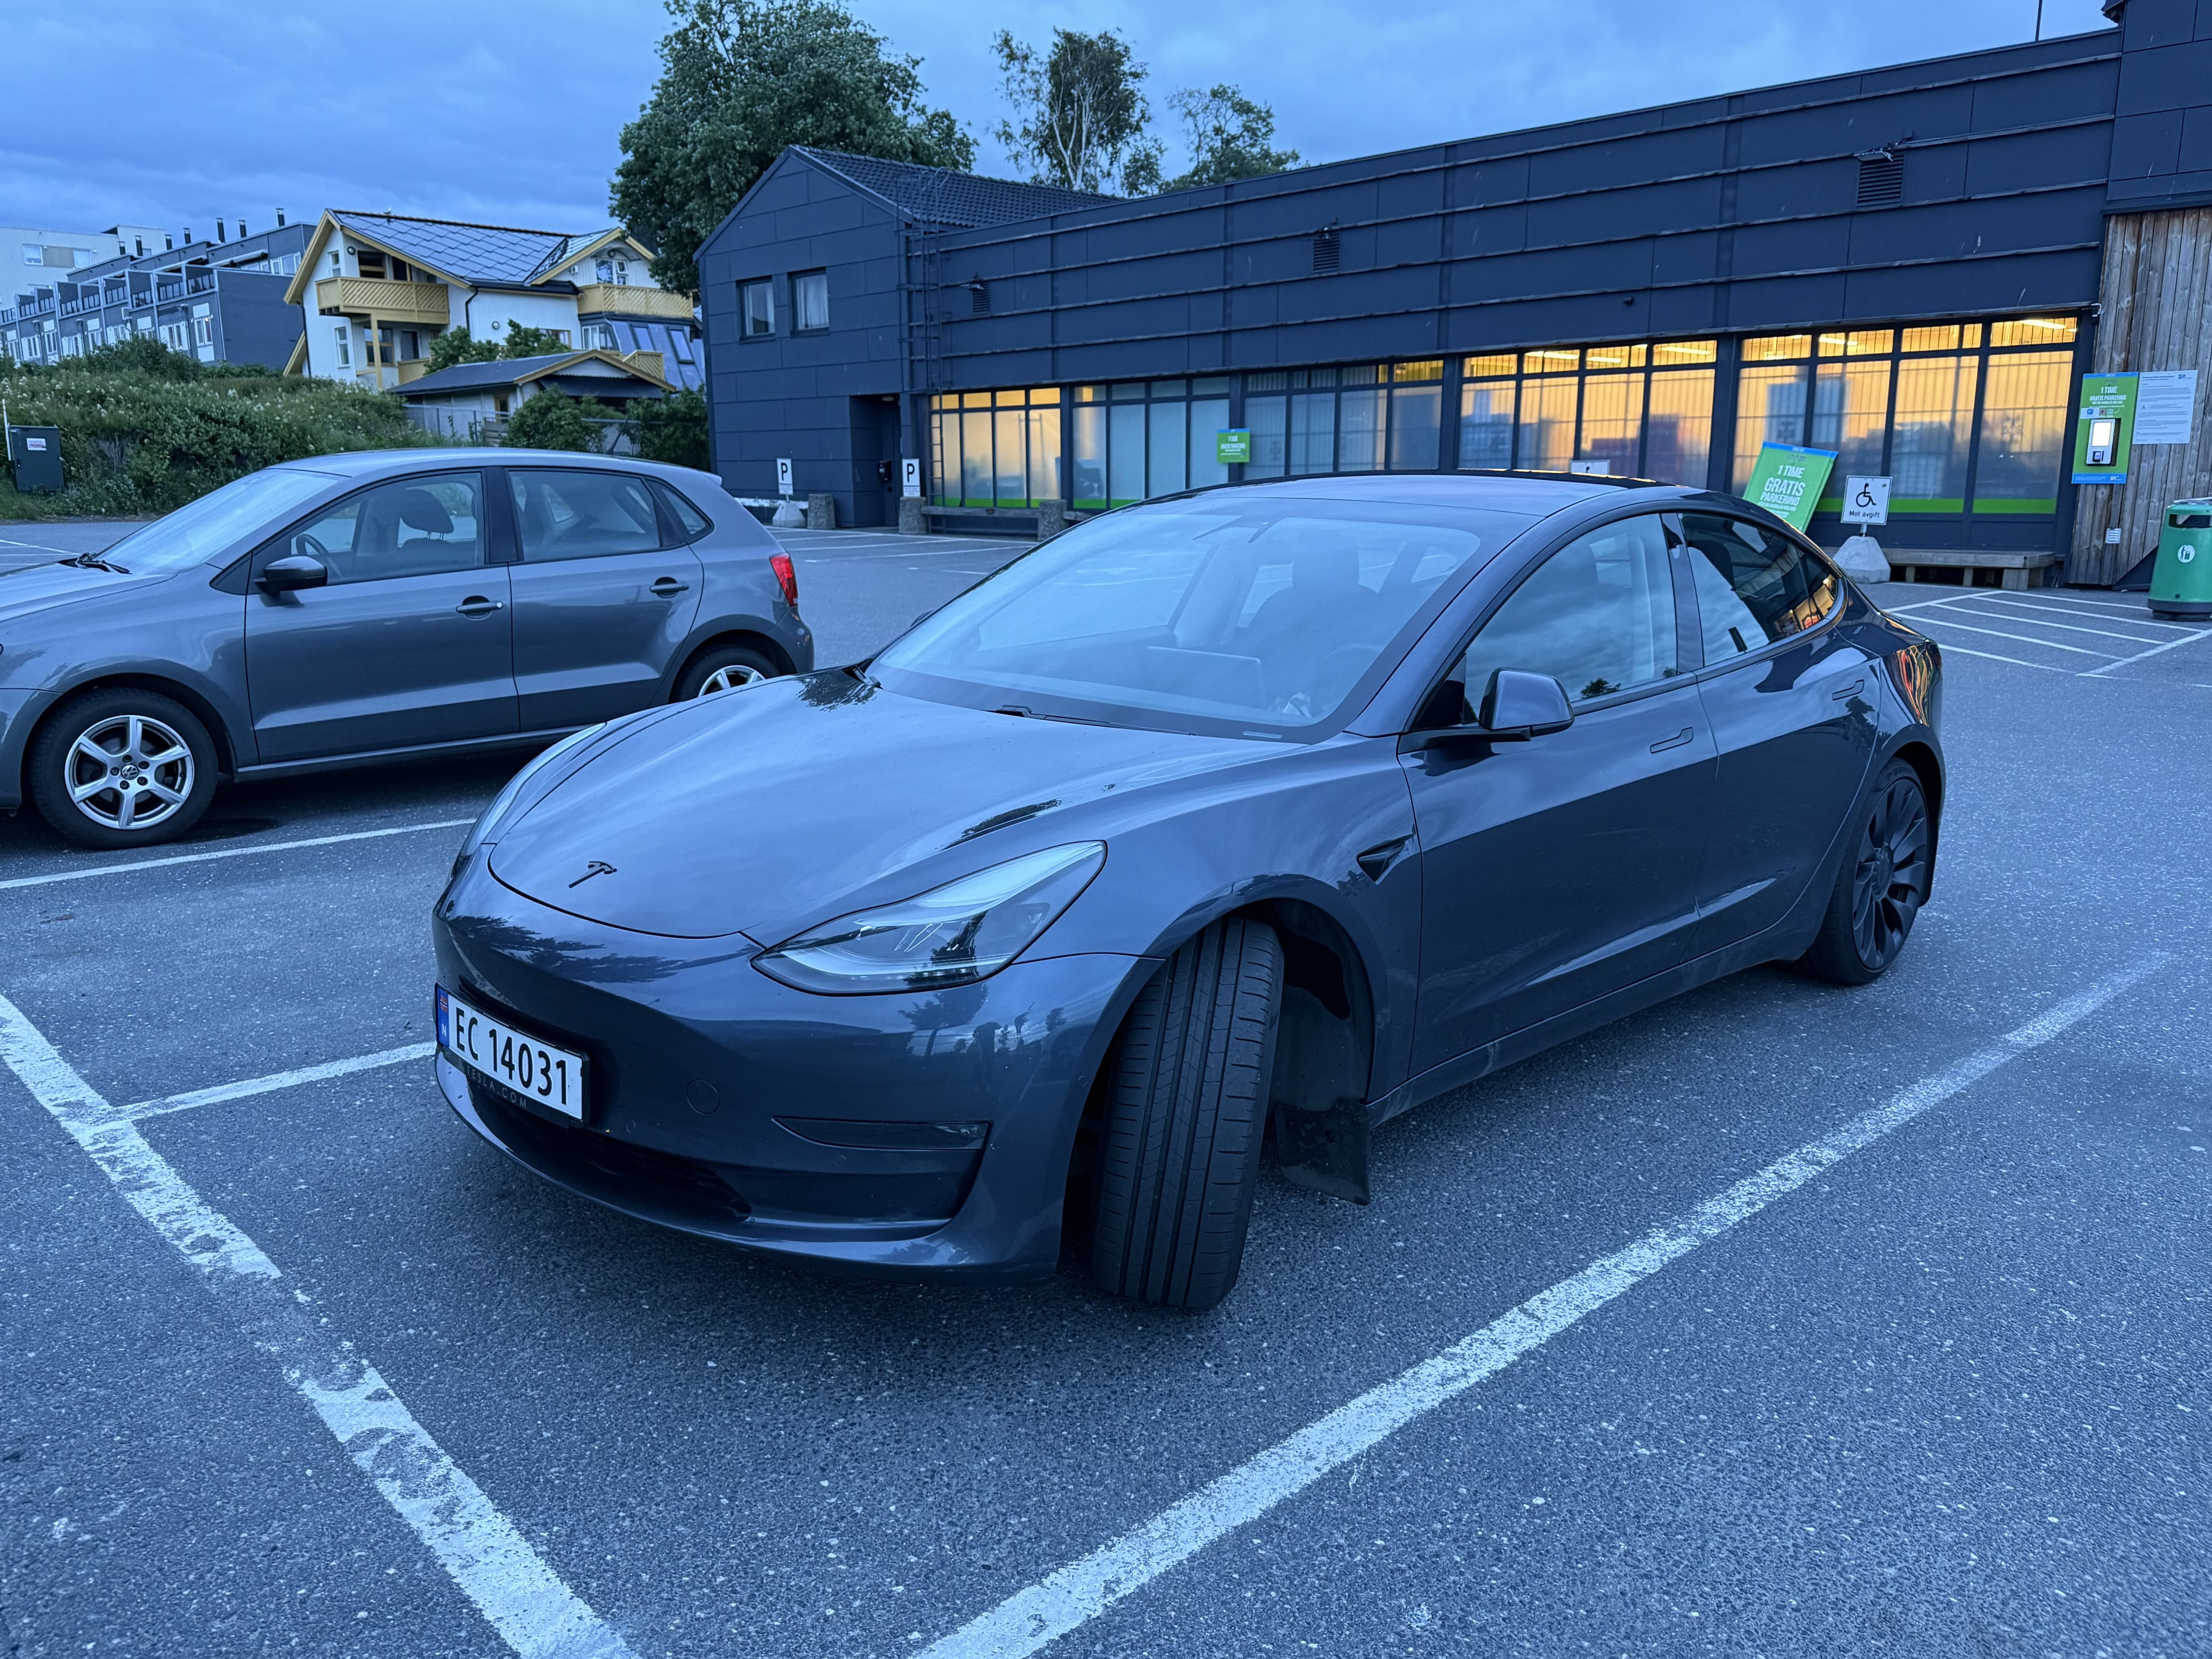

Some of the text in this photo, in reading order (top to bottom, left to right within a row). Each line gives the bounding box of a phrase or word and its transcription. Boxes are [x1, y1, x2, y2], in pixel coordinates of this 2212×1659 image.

[781, 462, 788, 481] P
[907, 463, 915, 483] P
[1778, 465, 1805, 478] 1 TIME
[1764, 477, 1806, 496] GRATIS
[1760, 492, 1800, 506] PARKERING
[441, 1024, 447, 1037] N
[456, 1007, 567, 1105] EC 14031
[467, 1065, 527, 1109] TESLA.COM
